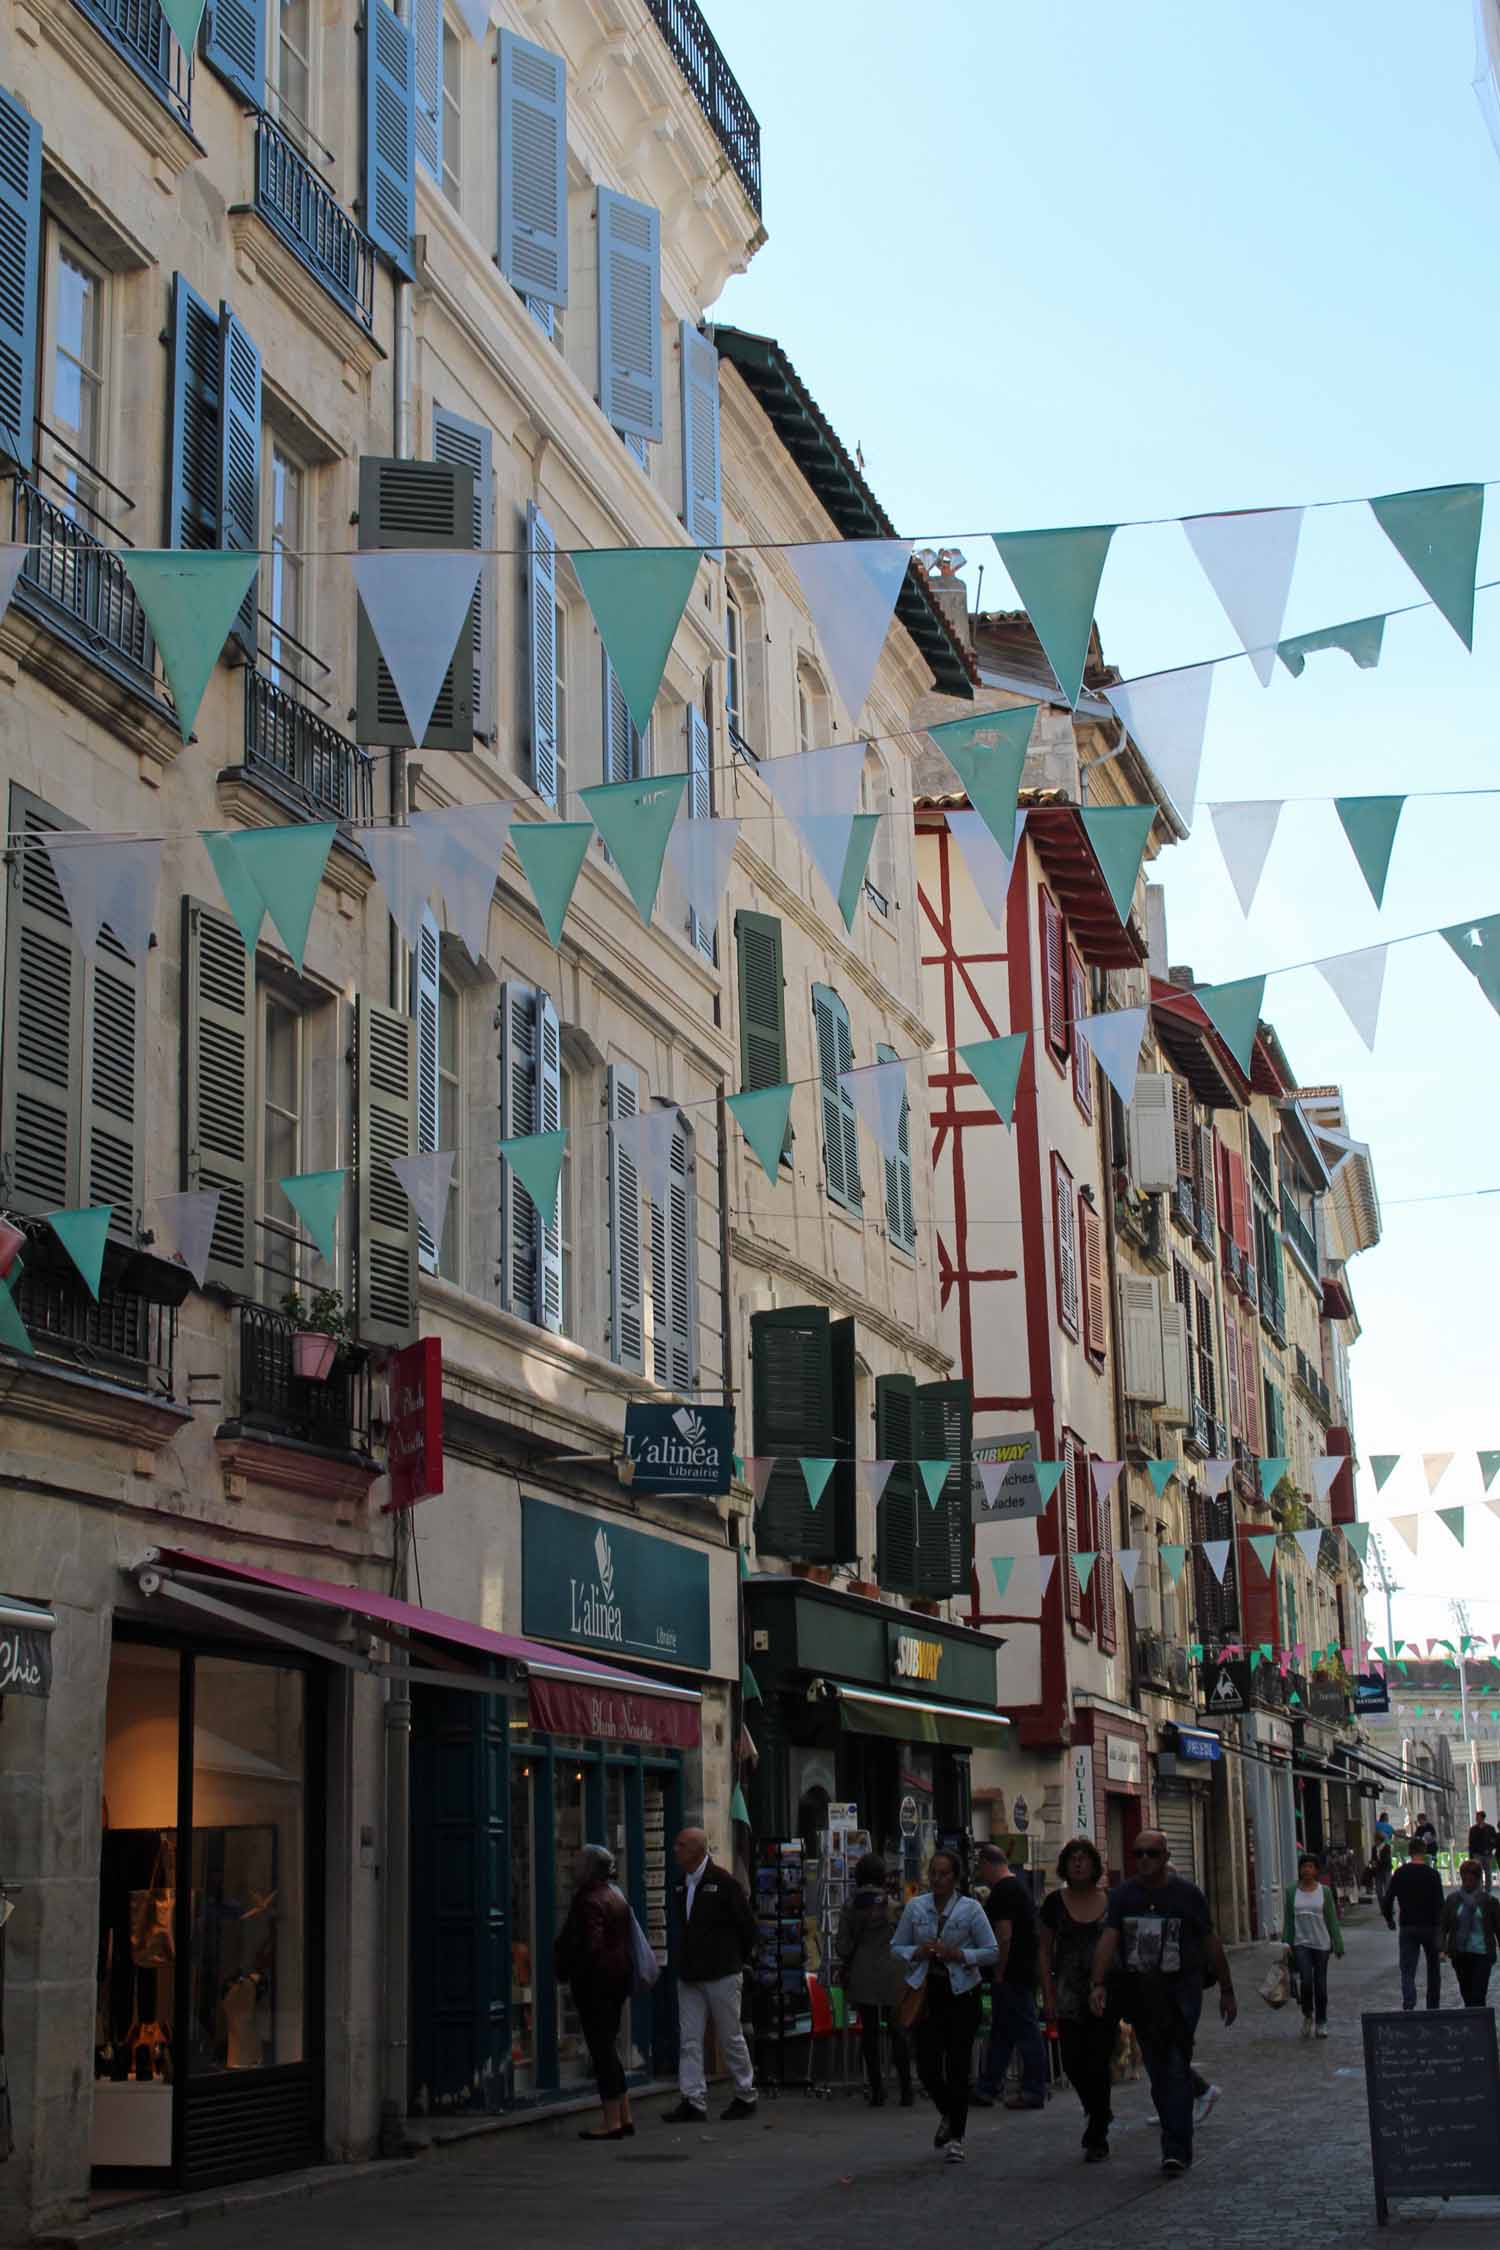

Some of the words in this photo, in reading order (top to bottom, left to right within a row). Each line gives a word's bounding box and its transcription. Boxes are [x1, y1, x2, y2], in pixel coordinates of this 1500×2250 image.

[972, 1442, 1032, 1464] SUBWAY
[668, 1465, 719, 1478] Librairie
[894, 1635, 943, 1681] SUBWAY
[1076, 1754, 1088, 1830] JULIEN
